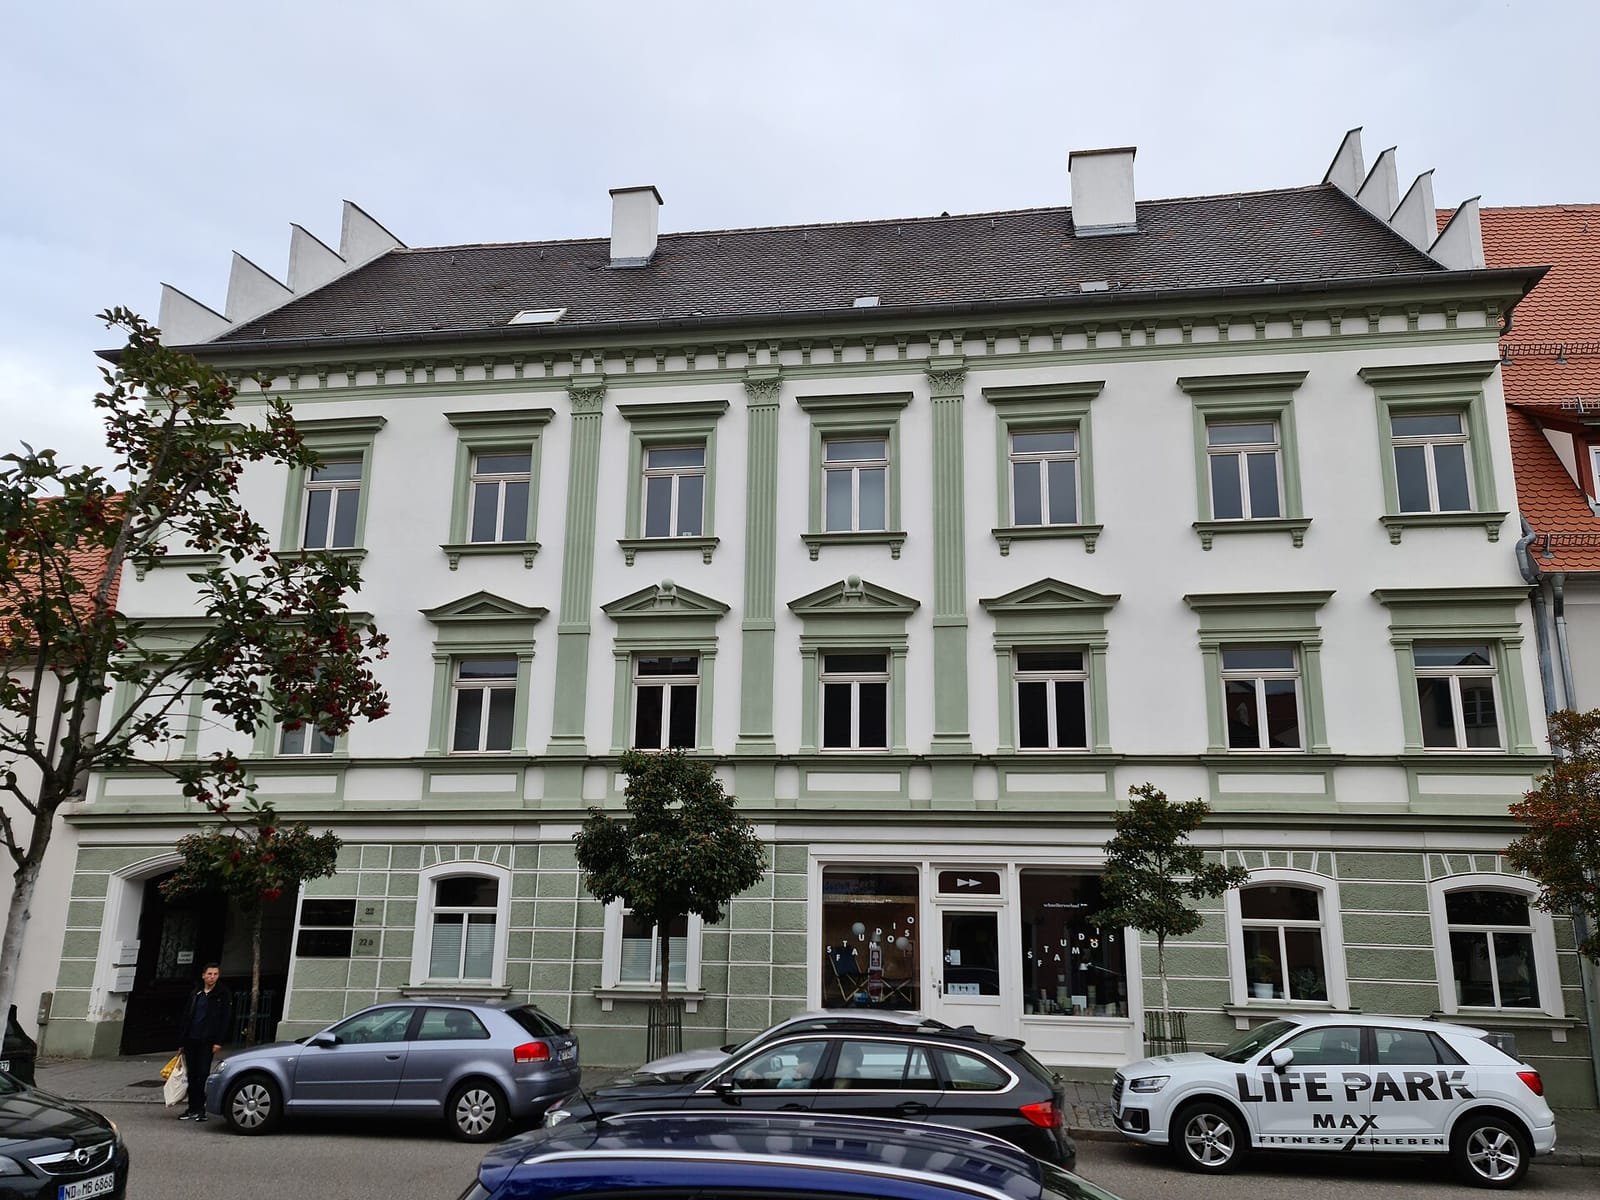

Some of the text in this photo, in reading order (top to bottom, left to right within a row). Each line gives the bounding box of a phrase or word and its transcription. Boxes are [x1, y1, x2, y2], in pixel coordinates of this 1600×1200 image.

[1235, 1070, 1478, 1103] LIFE PARK
[1258, 1136, 1444, 1146] FITNESS ERLEBEN
[65, 1174, 113, 1199] ND MB 6868
